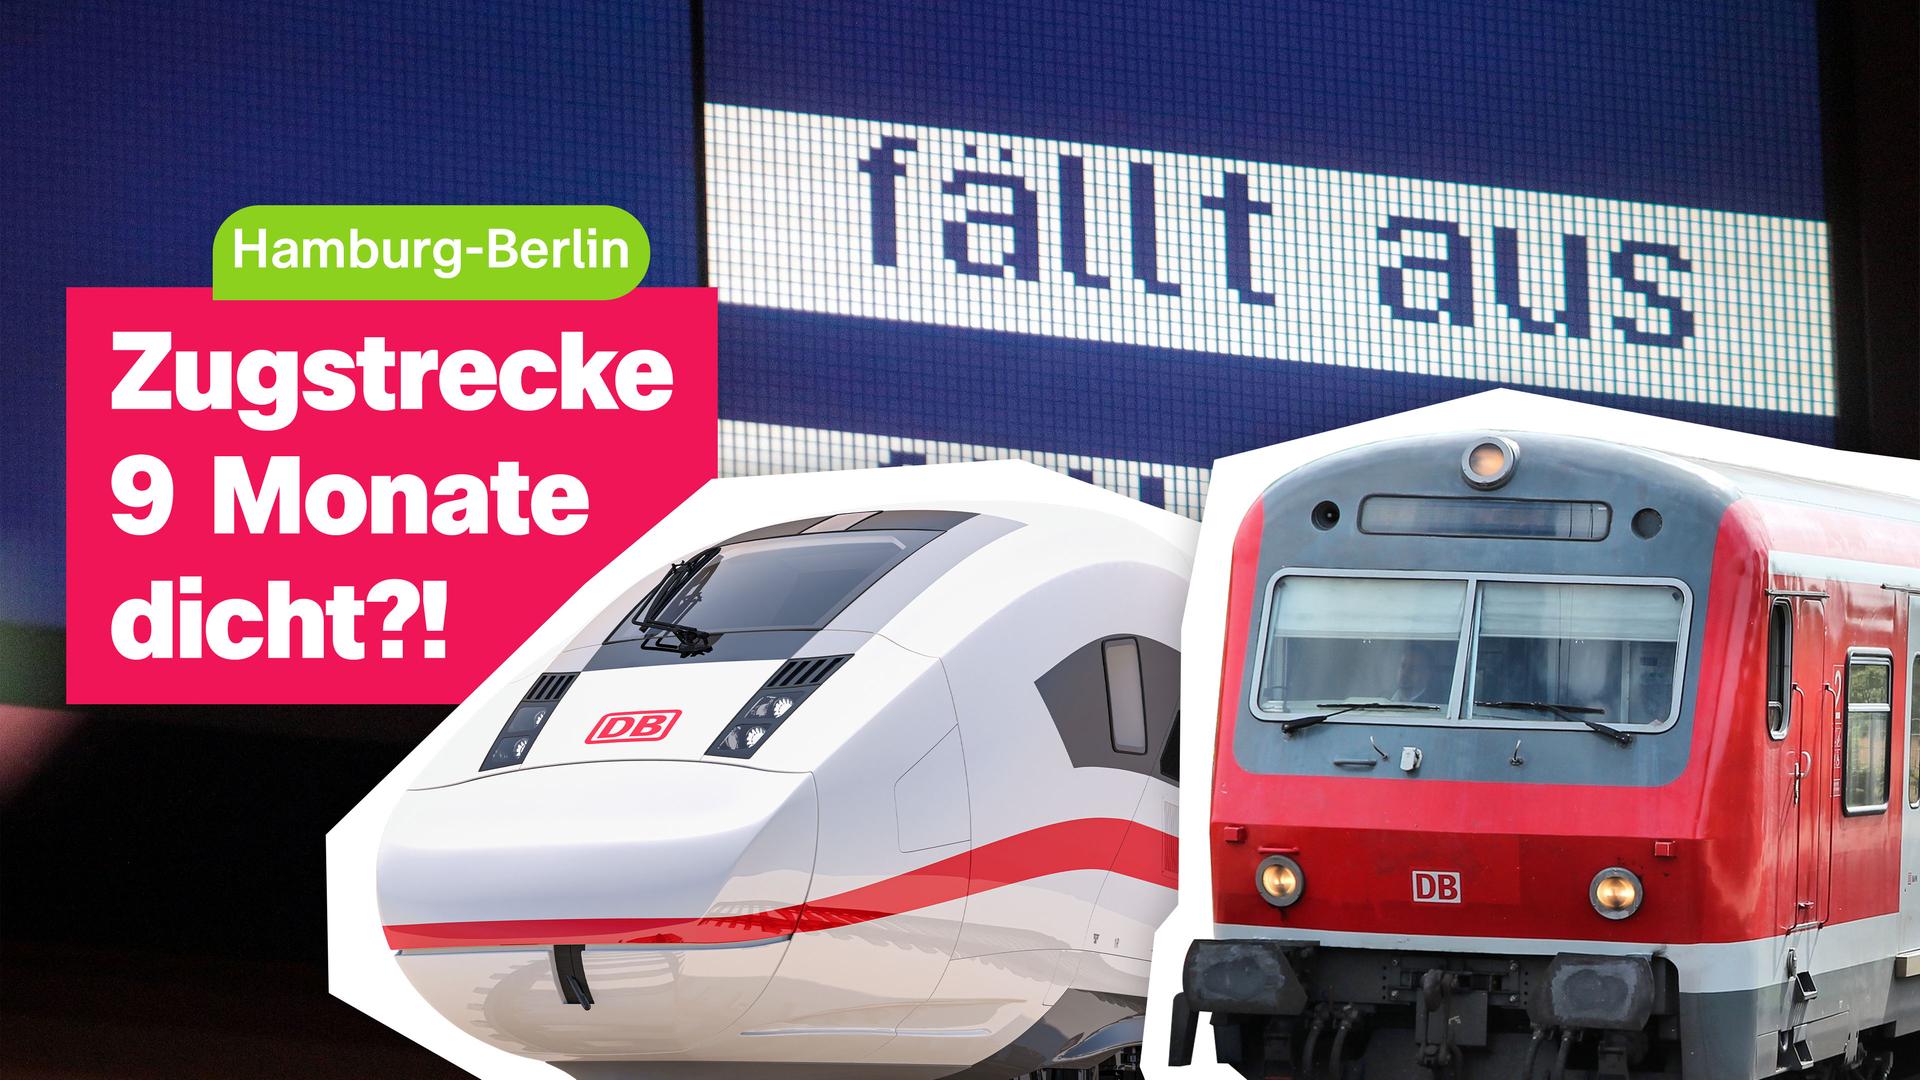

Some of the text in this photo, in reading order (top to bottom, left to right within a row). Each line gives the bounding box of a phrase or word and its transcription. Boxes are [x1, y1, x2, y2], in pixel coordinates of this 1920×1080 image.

[858, 136, 1694, 348] fällt aus
[597, 715, 667, 739] DB
[1416, 873, 1458, 900] DB
